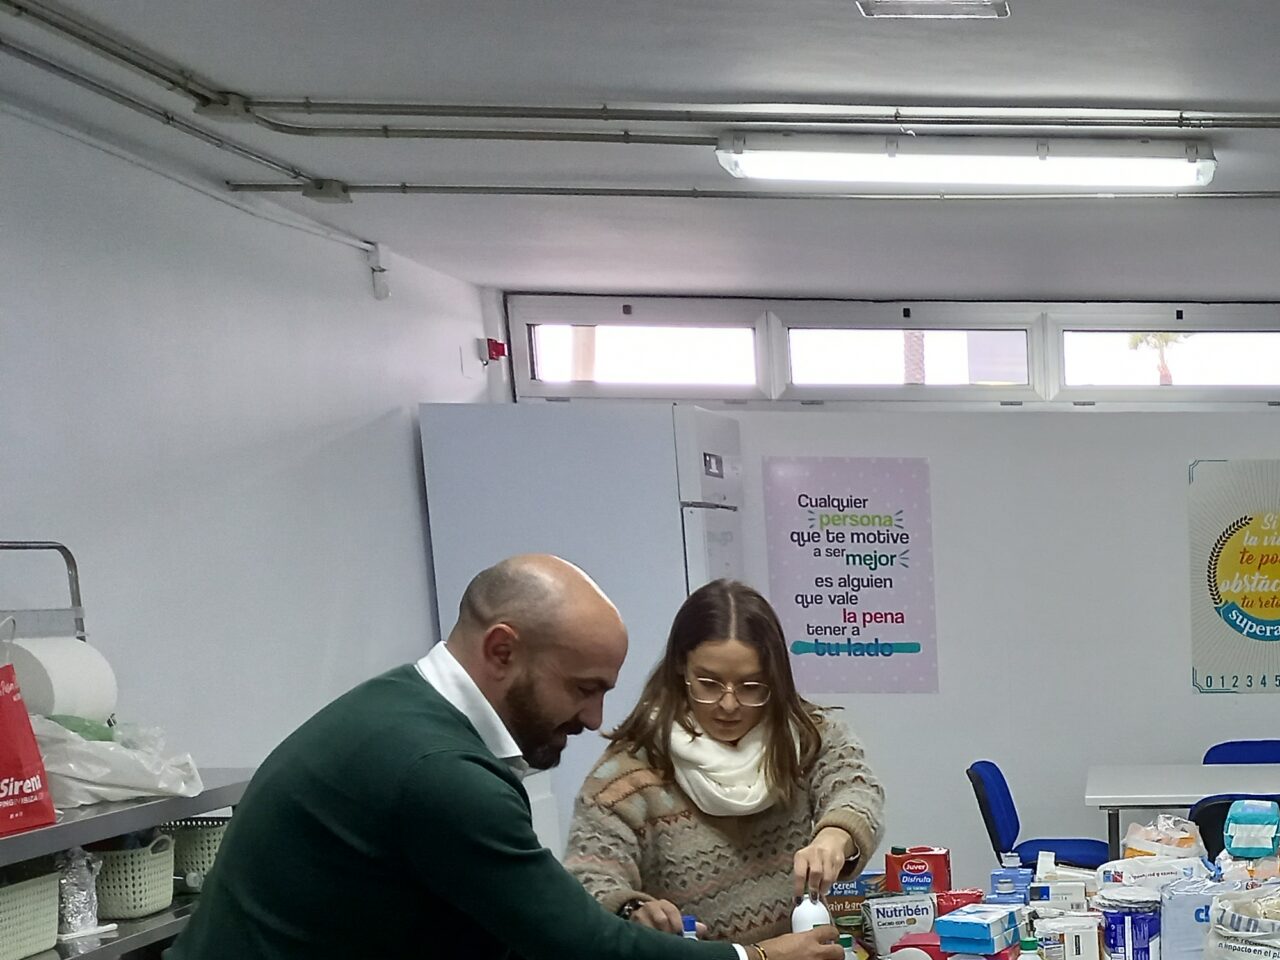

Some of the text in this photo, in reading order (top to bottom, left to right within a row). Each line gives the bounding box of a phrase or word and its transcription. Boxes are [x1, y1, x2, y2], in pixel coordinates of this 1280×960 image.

[797, 493, 868, 512] Cualquier
[819, 512, 893, 530] persona
[790, 529, 909, 547] que te motive
[1243, 531, 1259, 546] la
[813, 548, 897, 570] a ser mejor
[1239, 547, 1255, 565] te
[814, 574, 893, 592] es alguien
[794, 591, 858, 608] que vale
[1241, 596, 1255, 609] tu
[842, 608, 905, 628] la pena
[806, 623, 861, 636] tener a
[814, 638, 894, 657] tu lado
[832, 881, 857, 891] Cereal
[876, 904, 929, 919] Nutribén
[1224, 943, 1252, 954] impacto
[1253, 947, 1262, 955] en
[1264, 949, 1271, 957] el
